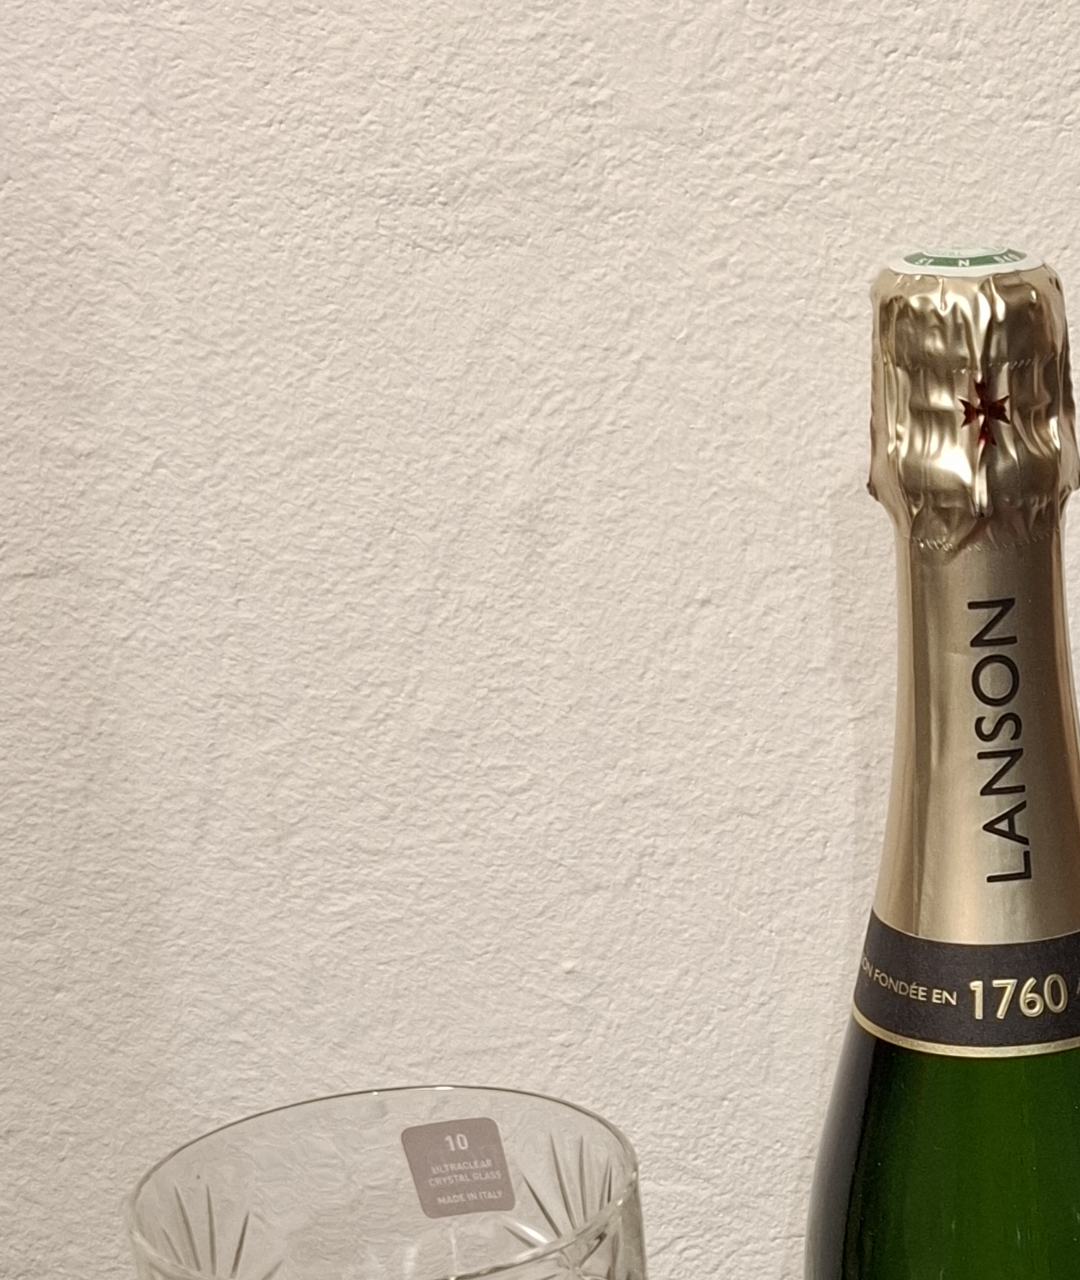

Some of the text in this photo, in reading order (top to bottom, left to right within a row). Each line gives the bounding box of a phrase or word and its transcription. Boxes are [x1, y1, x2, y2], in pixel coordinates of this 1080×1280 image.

[967, 597, 1032, 883] LANSON
[874, 969, 927, 1001] FONDÉE
[932, 988, 957, 1006] EN
[969, 974, 1068, 1020] 1760
[445, 1133, 469, 1152] 10
[431, 1159, 492, 1174] ULTRACLEAR
[428, 1170, 502, 1187] CRYSTAL GLASS
[437, 1190, 503, 1205] MADE IN ITALY
